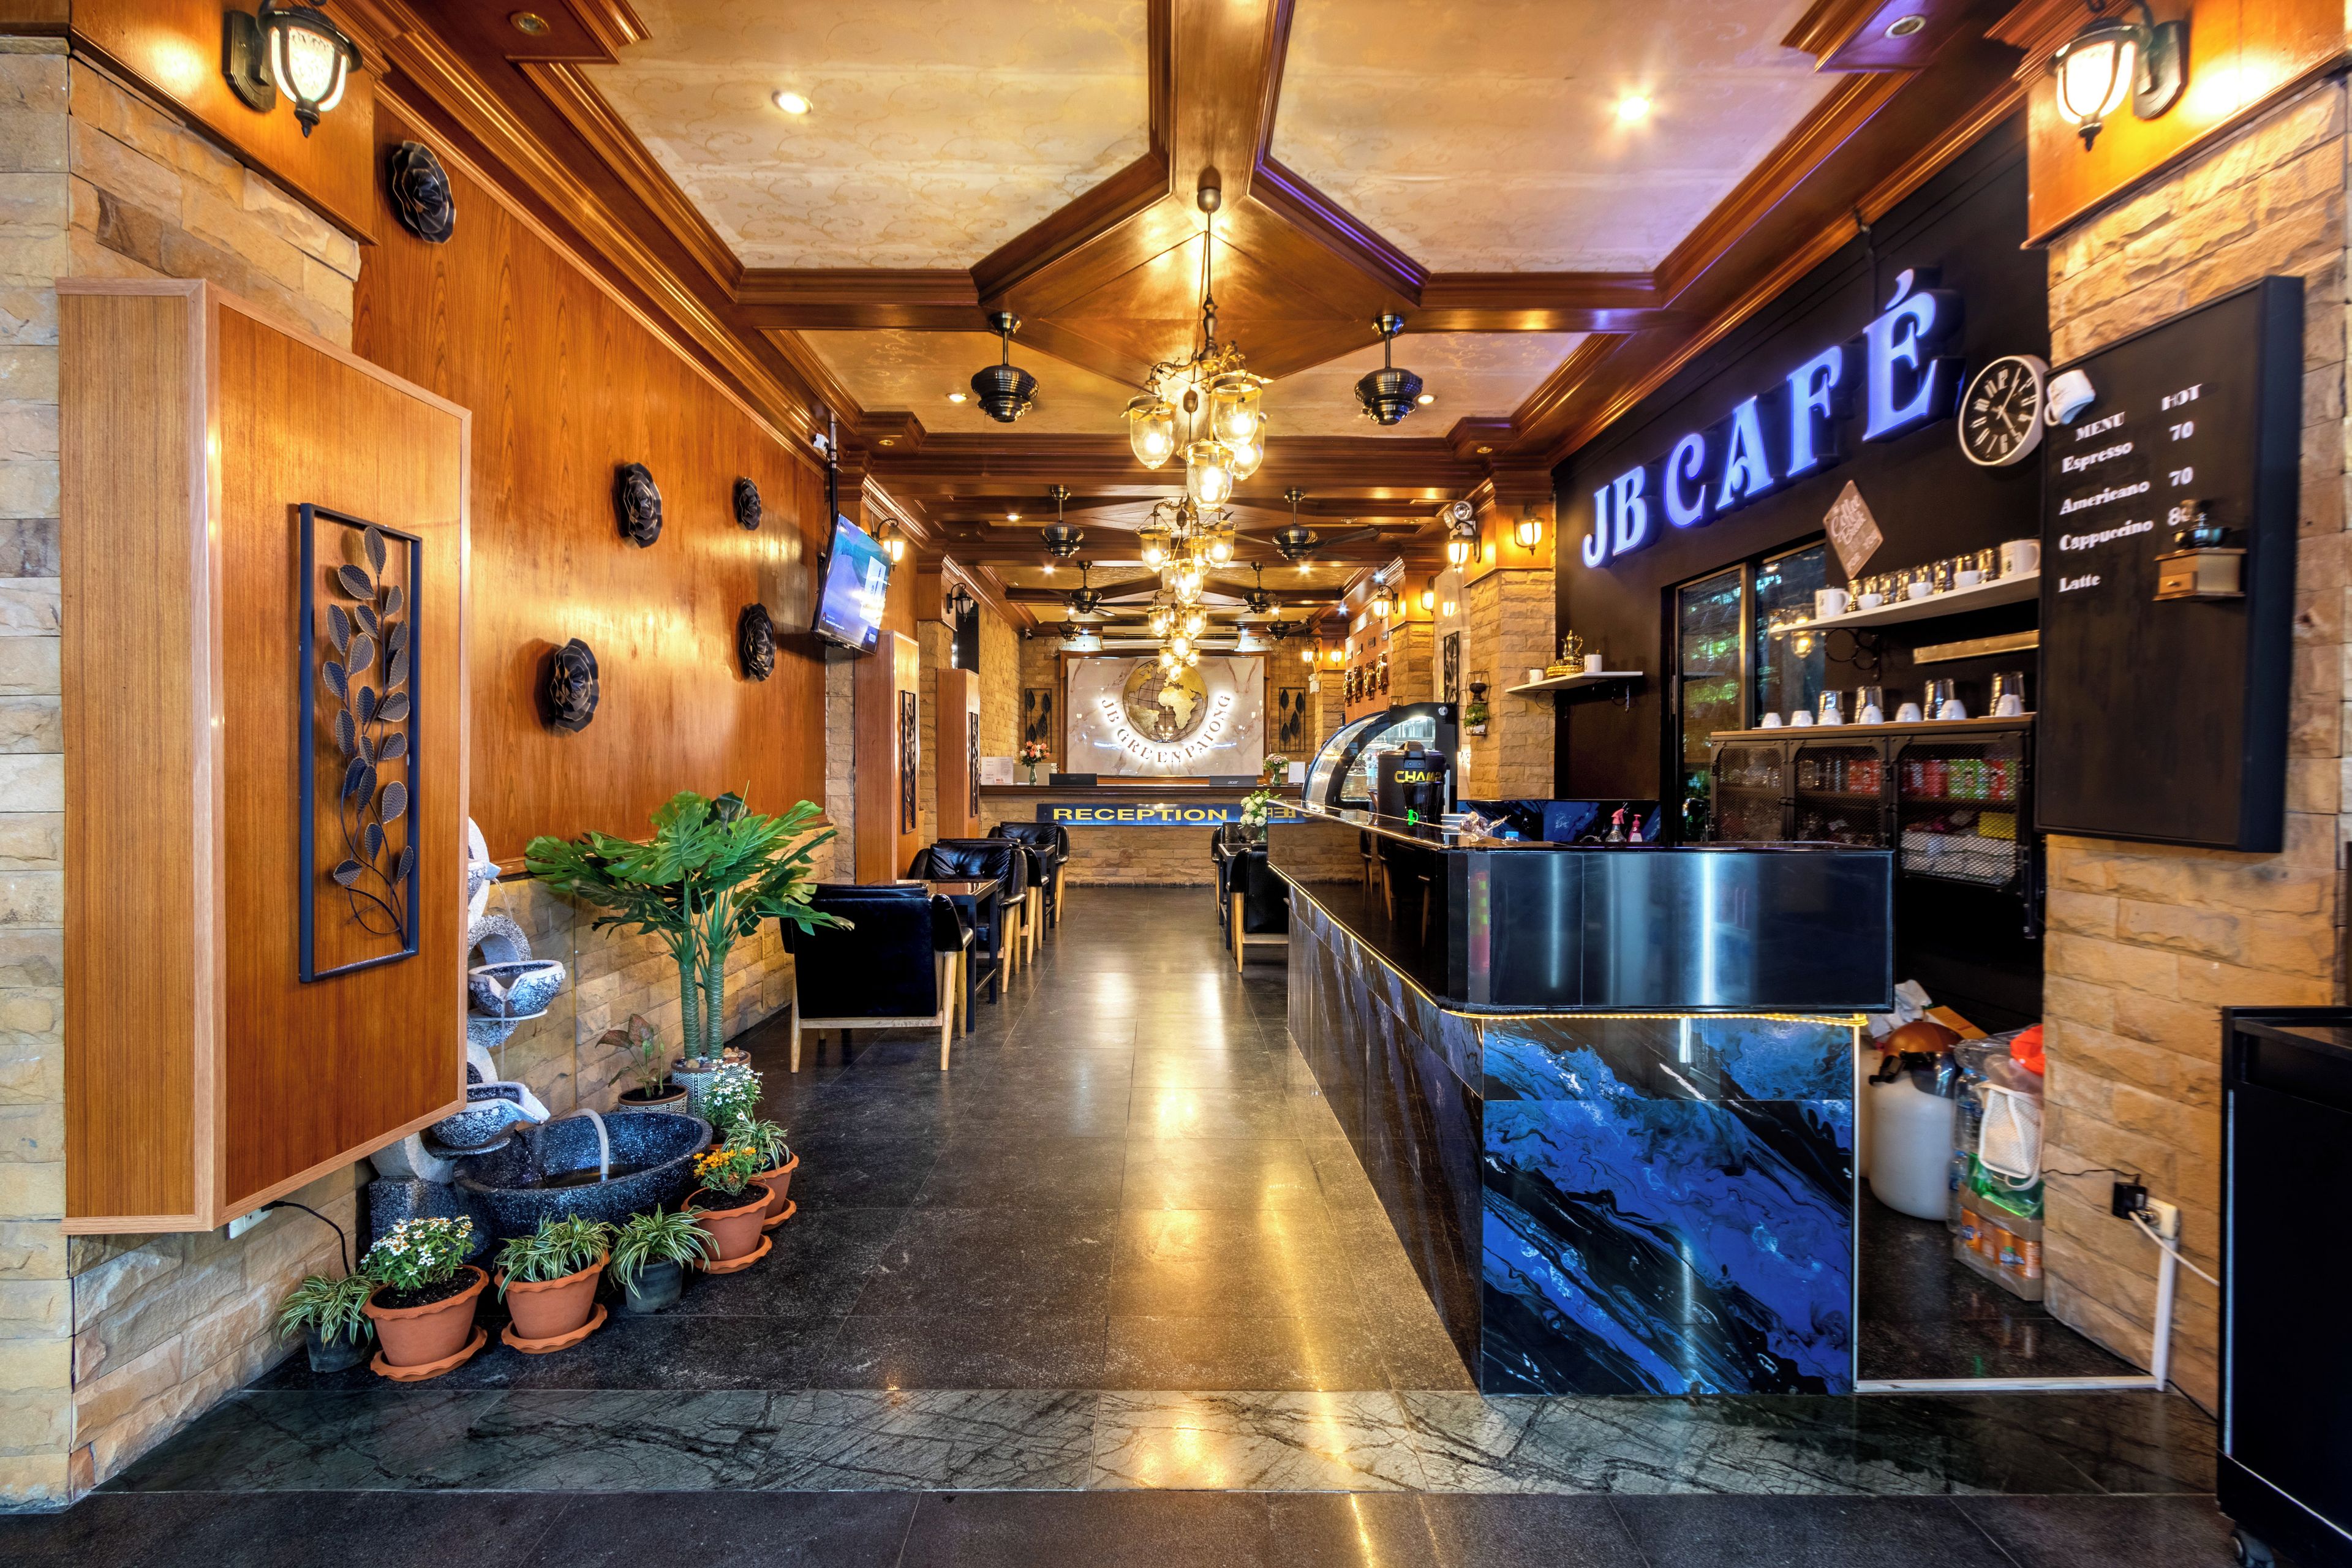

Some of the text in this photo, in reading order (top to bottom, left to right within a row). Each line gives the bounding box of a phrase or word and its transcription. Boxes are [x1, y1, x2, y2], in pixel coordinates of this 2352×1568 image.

[1582, 268, 1938, 568] JB CAFÉ
[2075, 383, 2203, 442] MENU HOT
[2062, 421, 2195, 473] Espresso 70
[2059, 466, 2193, 514] Americano 70
[2059, 519, 2154, 551] Cappuccino
[2058, 573, 2101, 593] Latte
[1101, 699, 1120, 723] JB
[1053, 807, 1227, 821] RECEPTION
